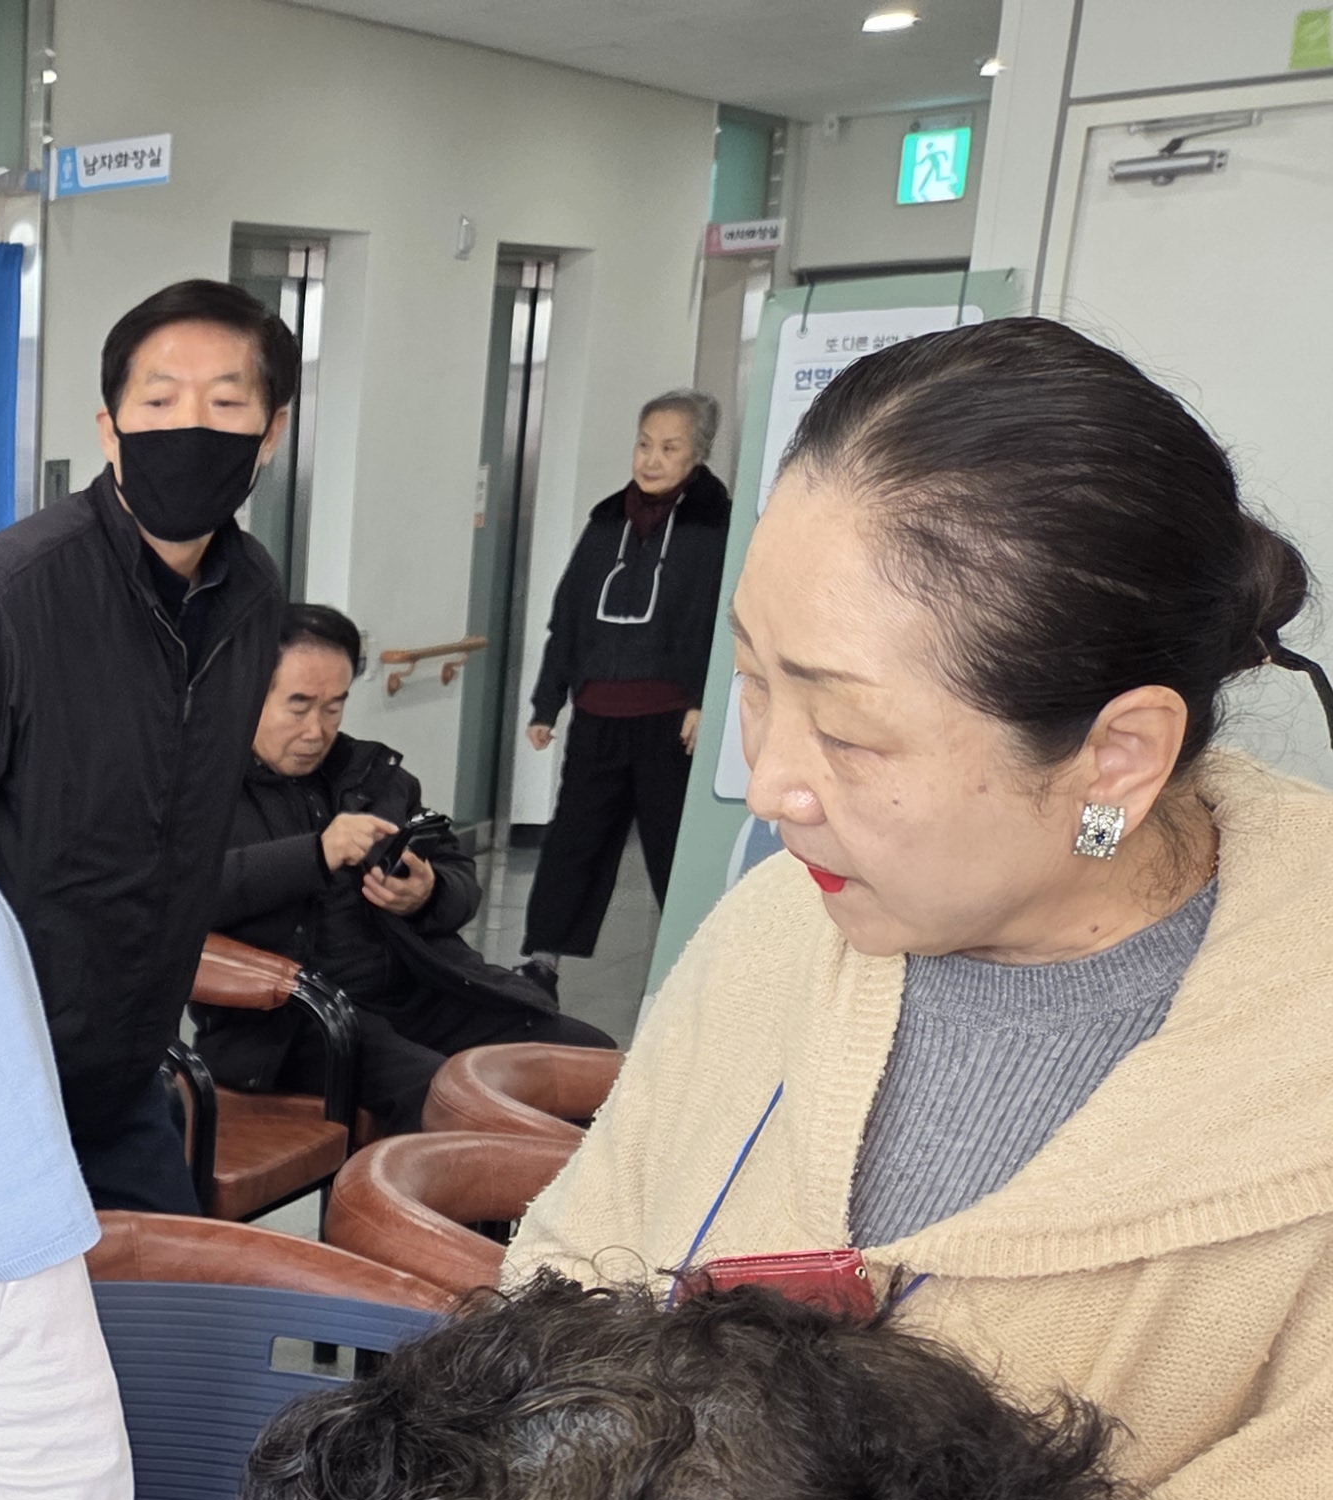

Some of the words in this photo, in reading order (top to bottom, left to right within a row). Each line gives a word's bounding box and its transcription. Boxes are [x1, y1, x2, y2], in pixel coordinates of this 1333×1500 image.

[83, 146, 162, 176] 남자화장실
[825, 337, 839, 353] 또
[842, 337, 869, 352] 다른
[794, 368, 840, 391] 연명
